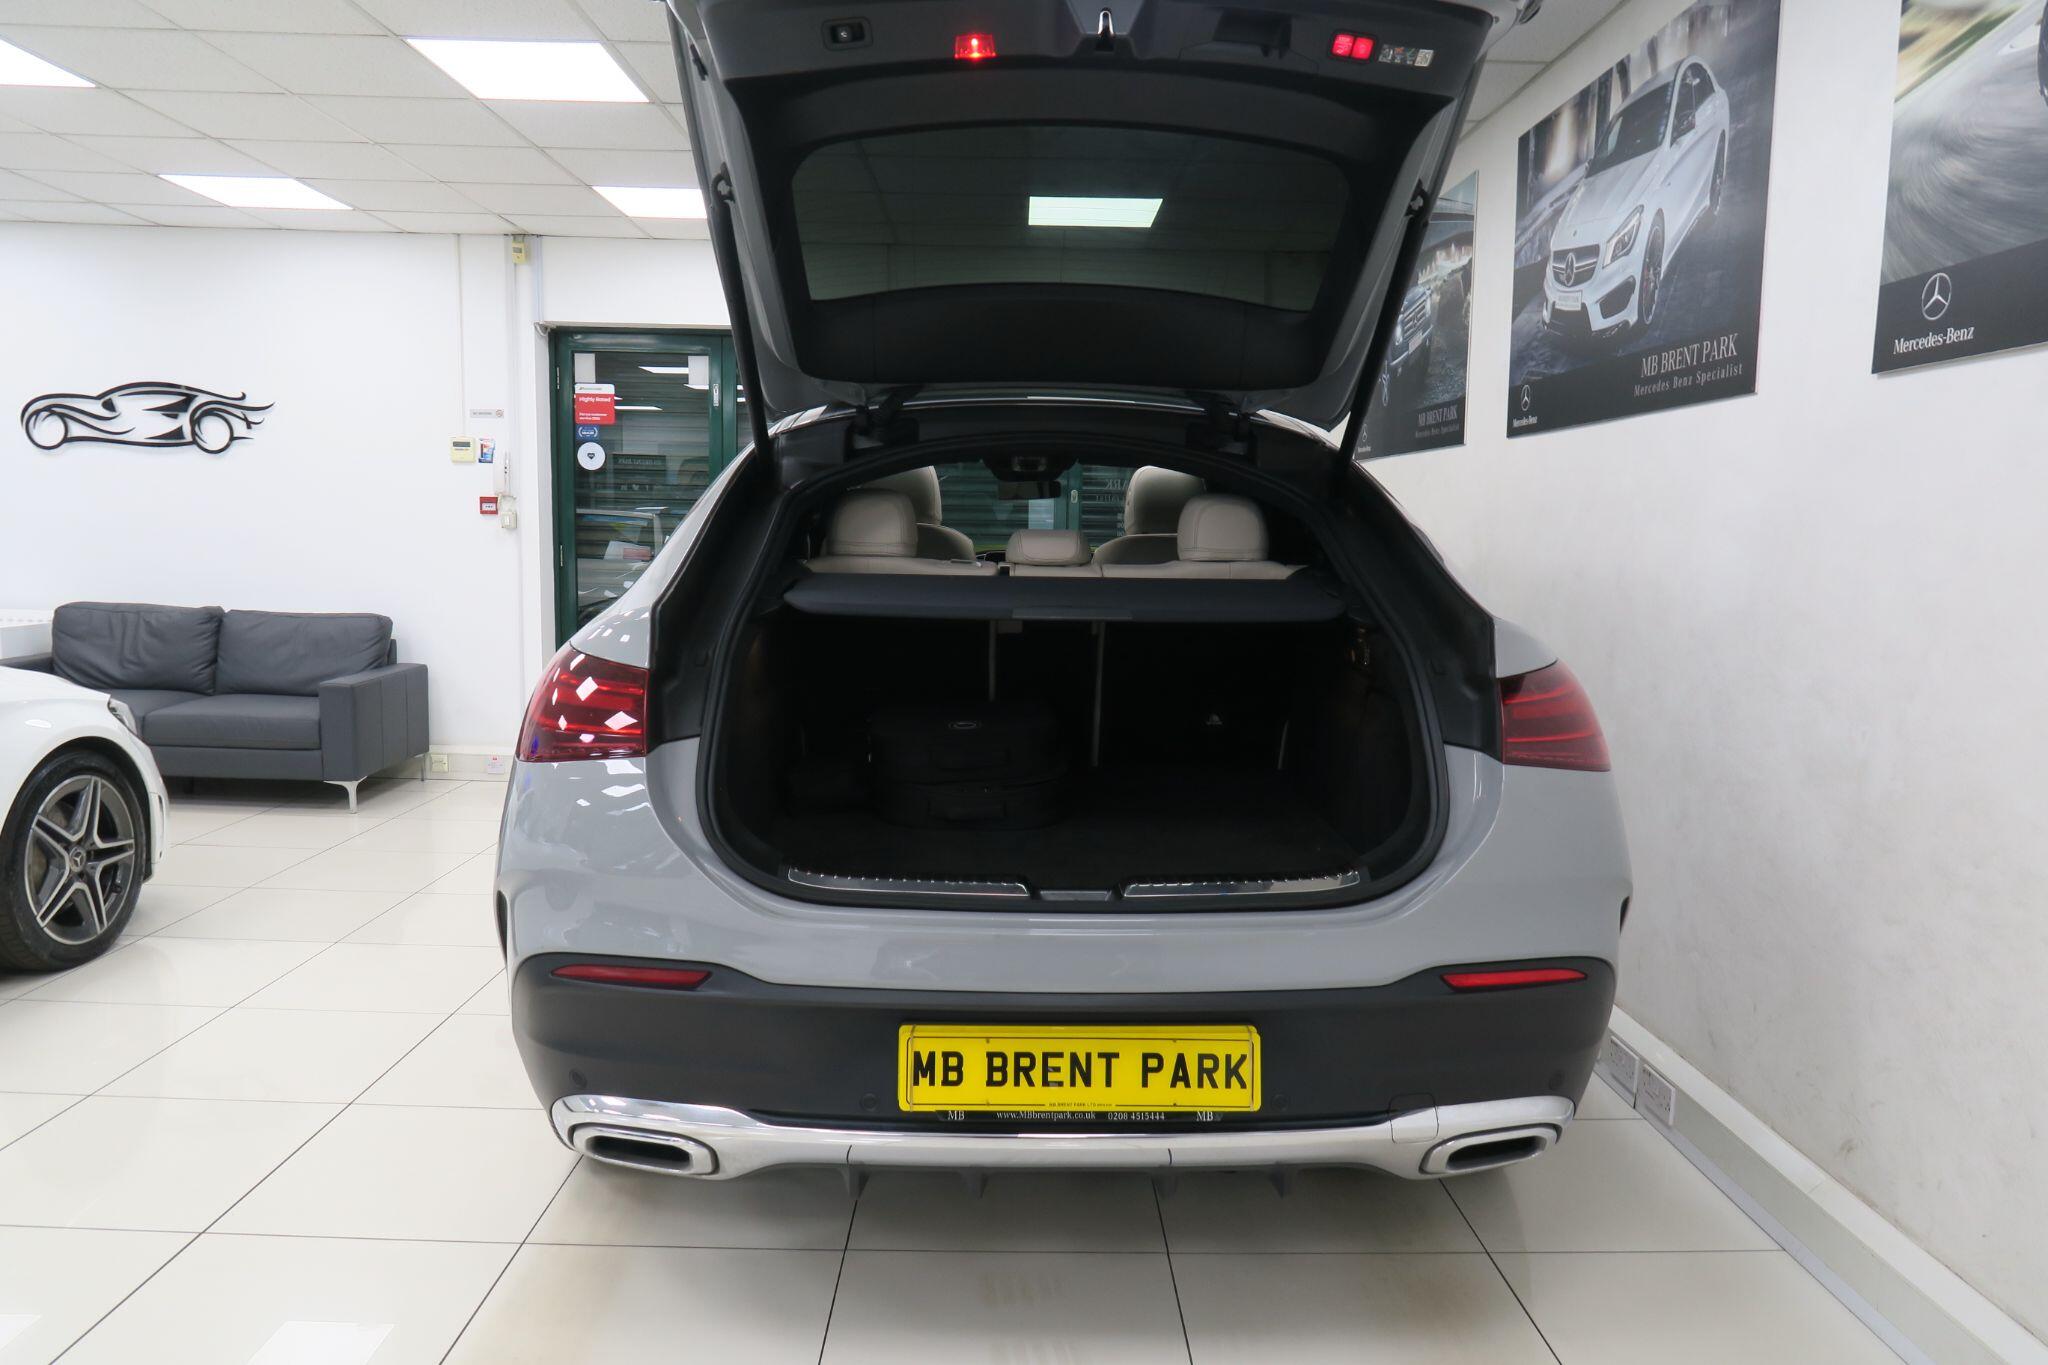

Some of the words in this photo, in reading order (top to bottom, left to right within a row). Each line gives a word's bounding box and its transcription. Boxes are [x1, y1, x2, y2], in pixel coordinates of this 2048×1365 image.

[1641, 354, 1659, 378] MB
[1660, 343, 1700, 373] BRENT
[1701, 333, 1739, 363] PARK
[1893, 326, 1975, 355] Mercedes-Benz
[1633, 380, 1670, 397] Mercedes
[1672, 375, 1693, 389] Benz
[1696, 363, 1743, 386] Specialist
[912, 1050, 964, 1088] MB
[985, 1051, 1120, 1088] BRENT
[1141, 1052, 1248, 1090] PARK
[947, 1110, 965, 1121] MB
[996, 1110, 1096, 1122] www.MBbrentpark.co.uk
[1107, 1111, 1128, 1121] 0208
[1131, 1111, 1165, 1121] 4515444
[1196, 1110, 1214, 1122] MB
